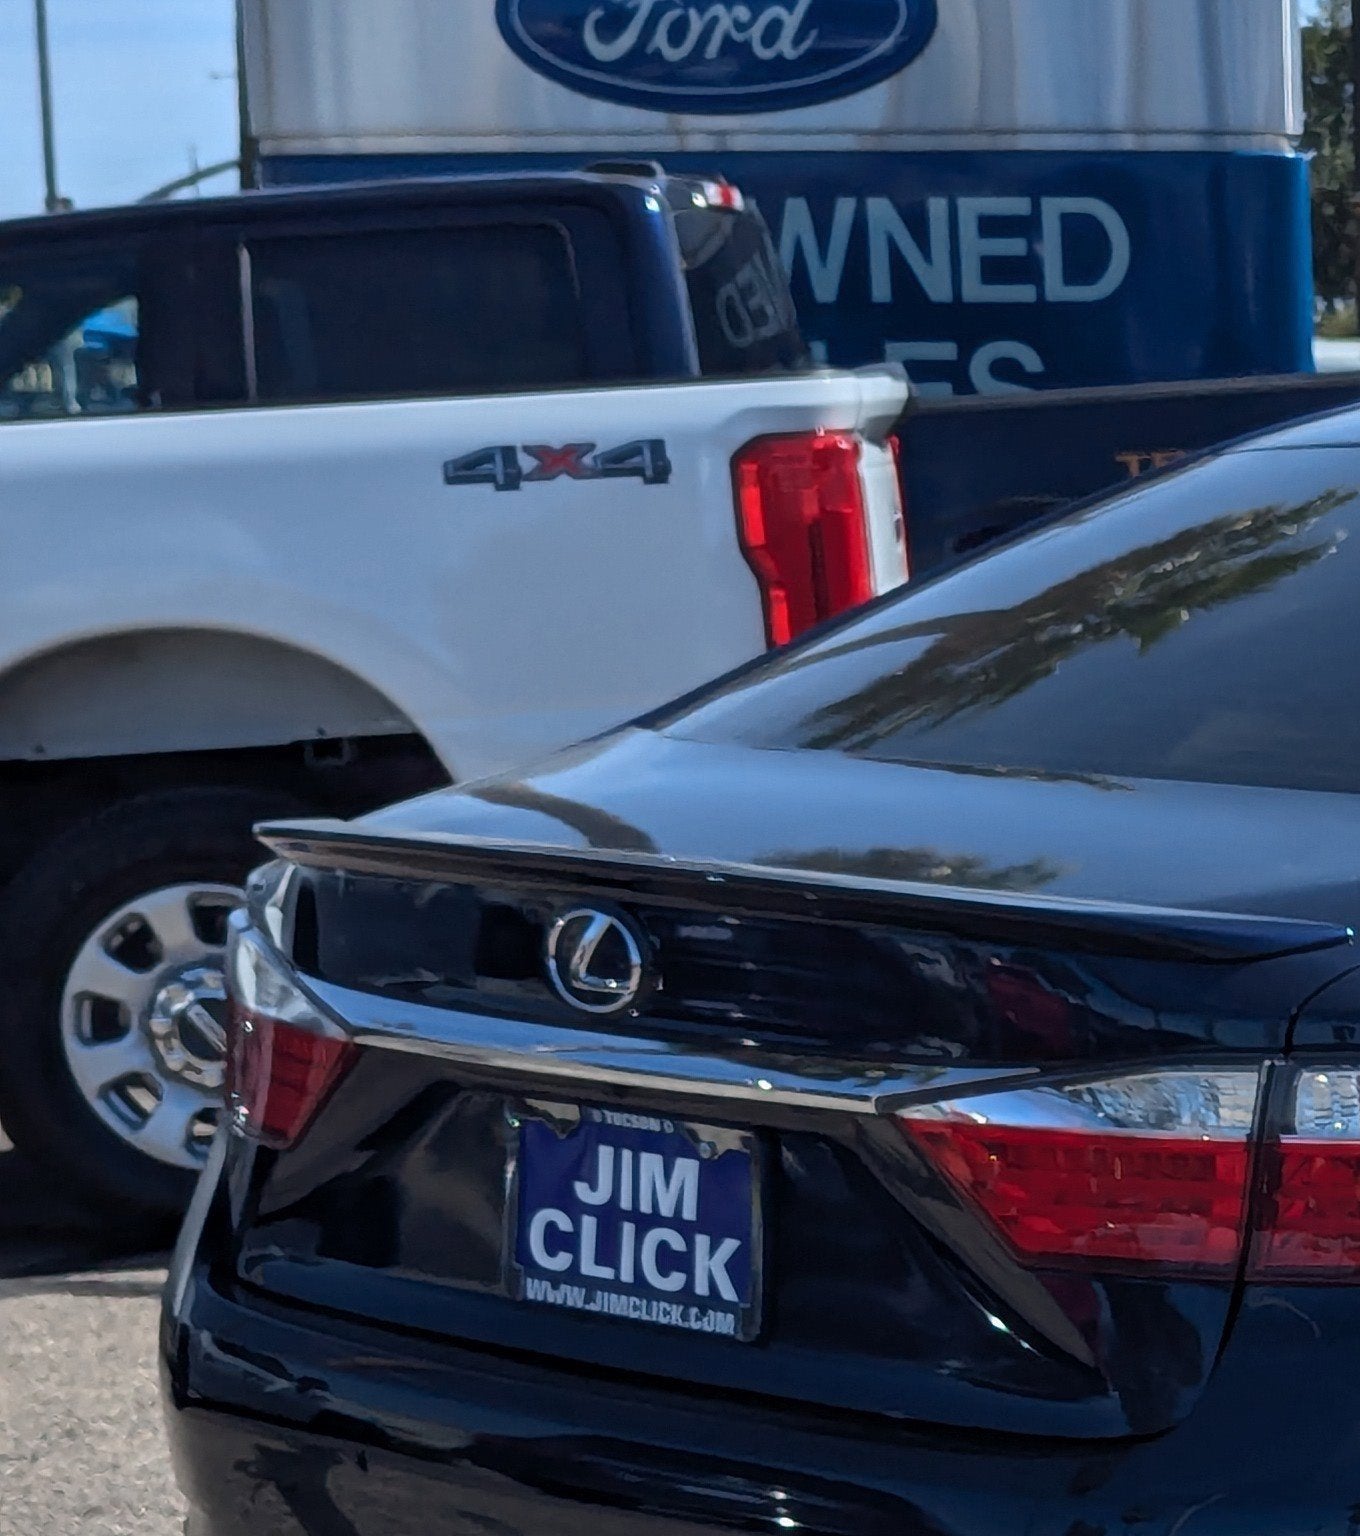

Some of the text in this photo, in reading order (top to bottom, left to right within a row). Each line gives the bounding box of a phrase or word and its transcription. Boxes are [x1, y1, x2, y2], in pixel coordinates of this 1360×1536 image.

[574, 1144, 699, 1221] JIM
[529, 1208, 742, 1303] CLICK
[526, 1277, 735, 1336] WWW.JIMCLICK.COM
